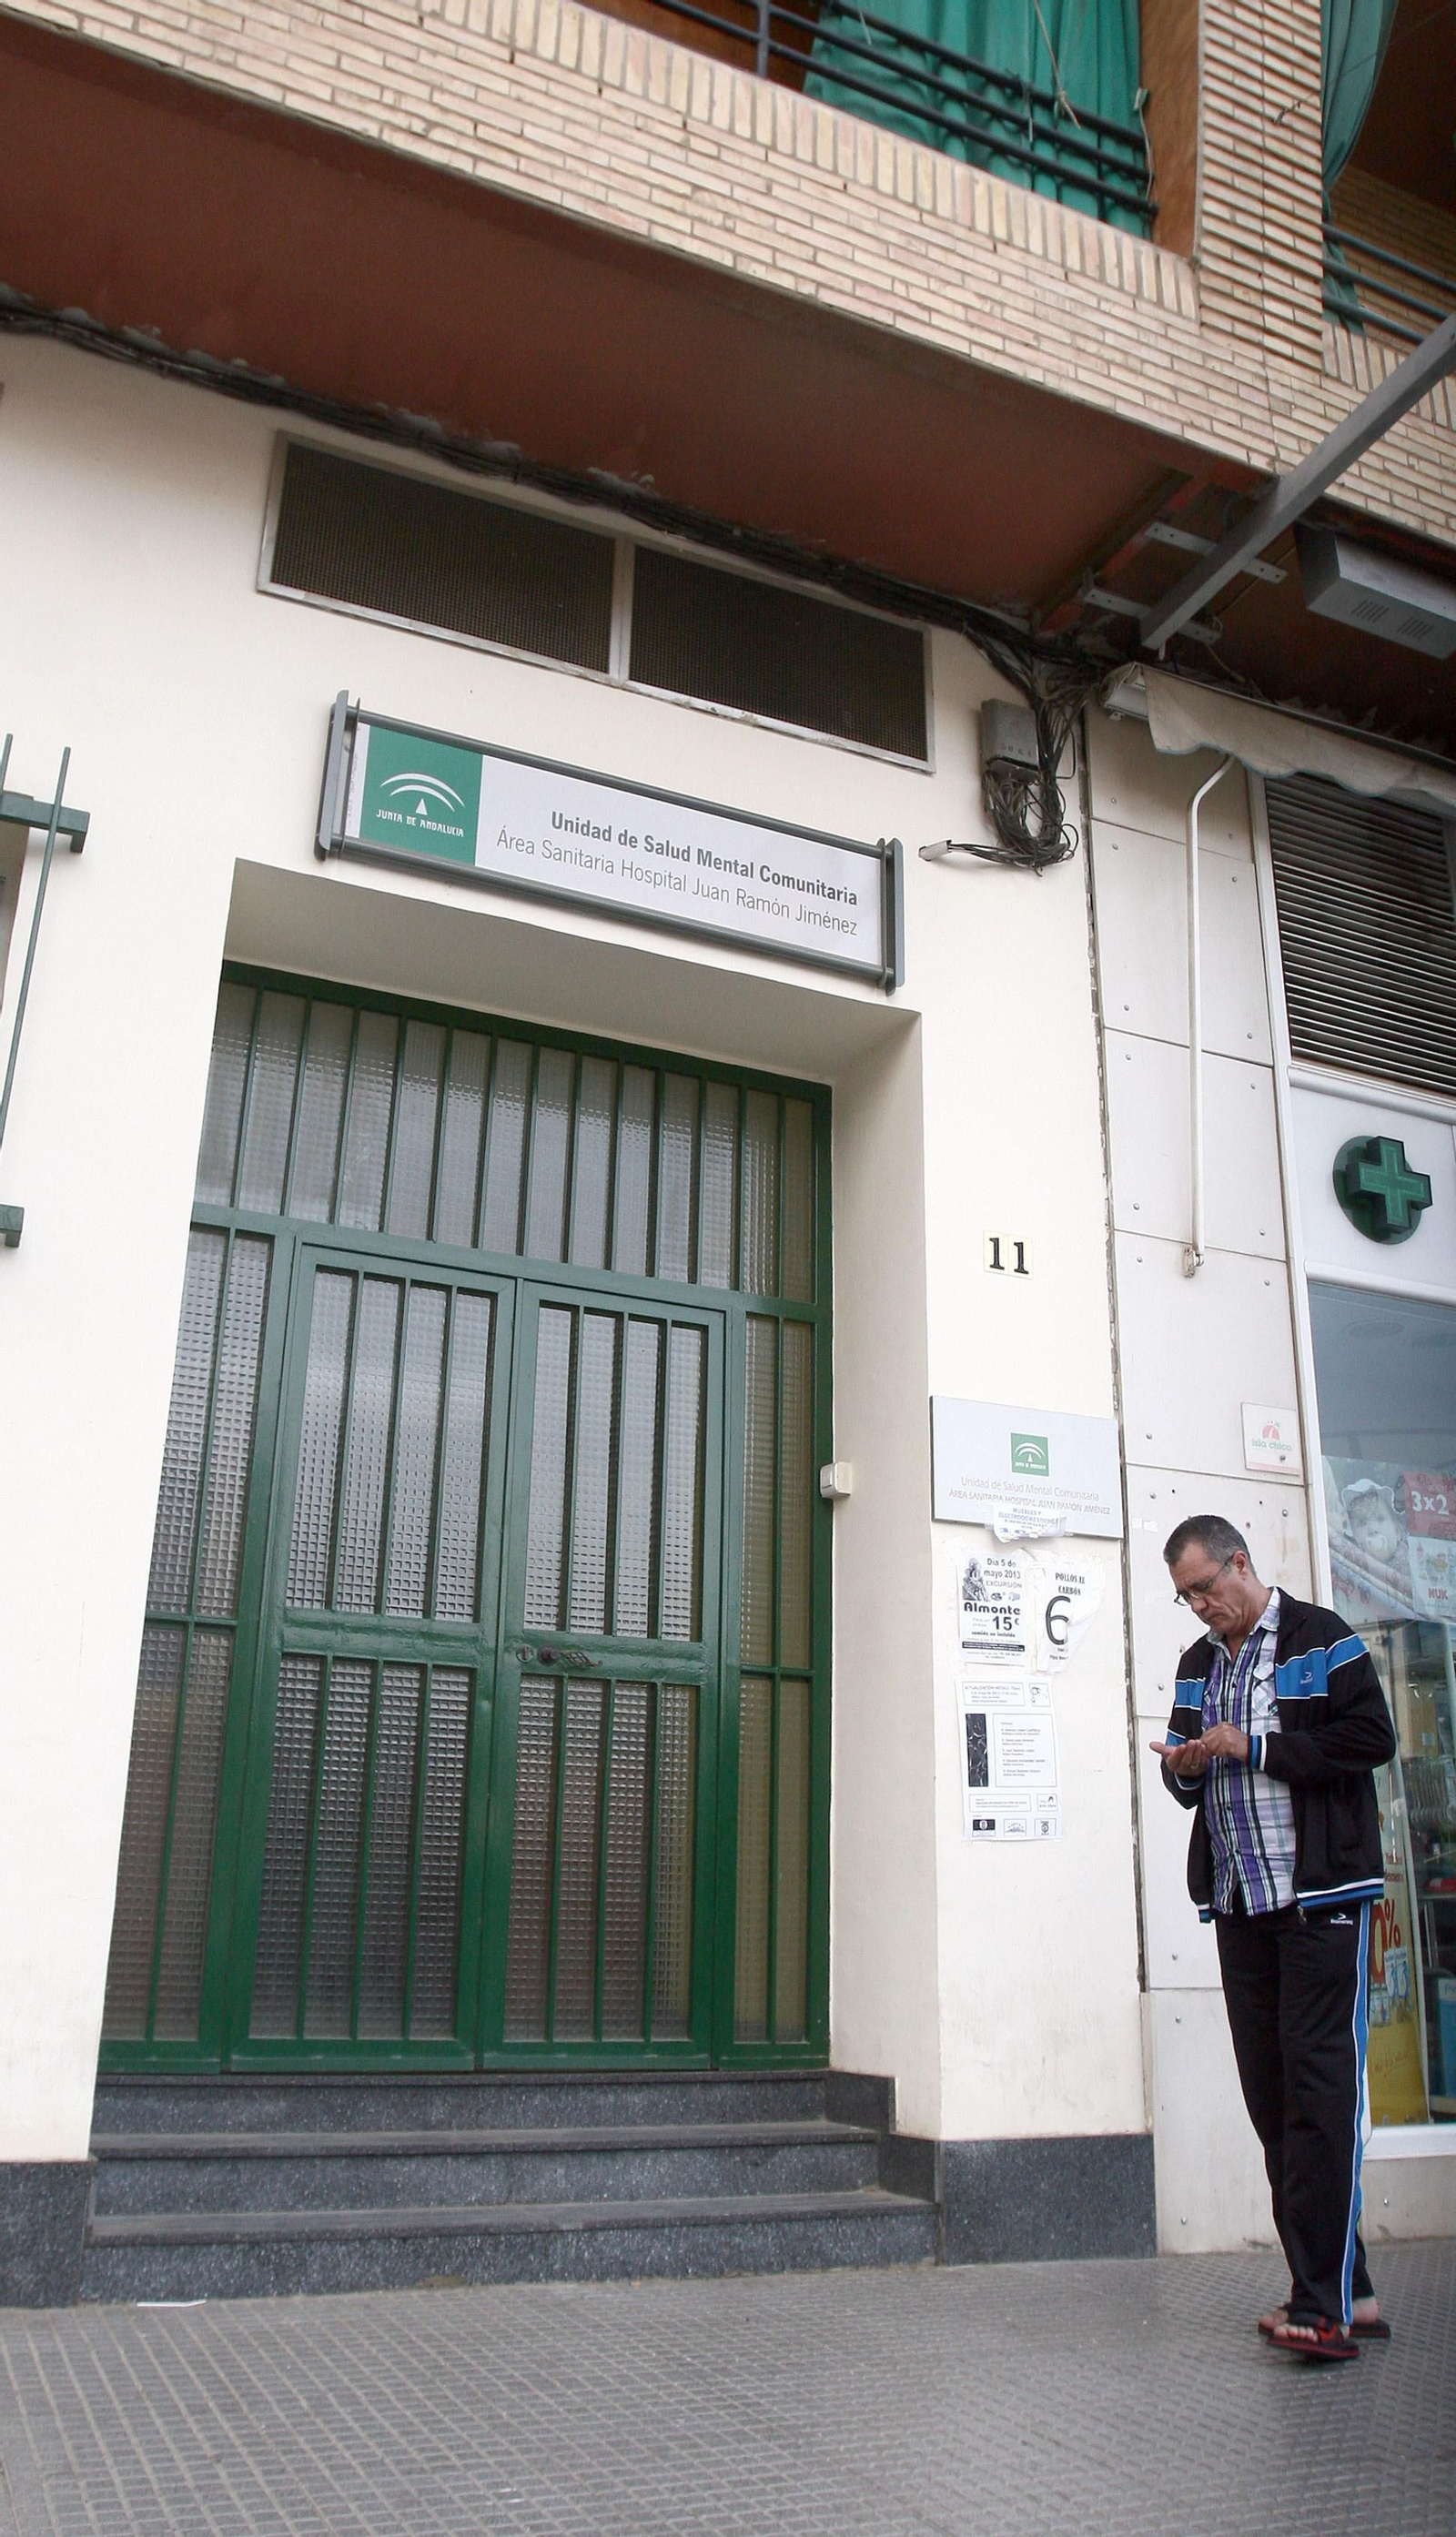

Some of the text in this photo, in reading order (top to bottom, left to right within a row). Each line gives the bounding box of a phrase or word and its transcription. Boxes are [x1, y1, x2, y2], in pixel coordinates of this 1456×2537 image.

[376, 809, 464, 837] JUNTA DE ANDALUCIA
[551, 810, 857, 905] Unidad de Salud Mental Comunitaria
[496, 824, 857, 936] Área Sanitaria Hospital Juan Ramón Jiménez
[988, 1237, 1029, 1275] 11
[1252, 1438, 1292, 1451] isla chica
[961, 1476, 1099, 1501] Unidad de Salud Mental Comunitaria
[969, 1491, 1004, 1503] SANITARIA
[1005, 1496, 1036, 1508] HOSPITAL
[1038, 1500, 1056, 1509] JUAN
[984, 1570, 1021, 1580] mayo 2013
[1055, 1572, 1077, 1583] POLLOS
[964, 1602, 1021, 1615] Almonte
